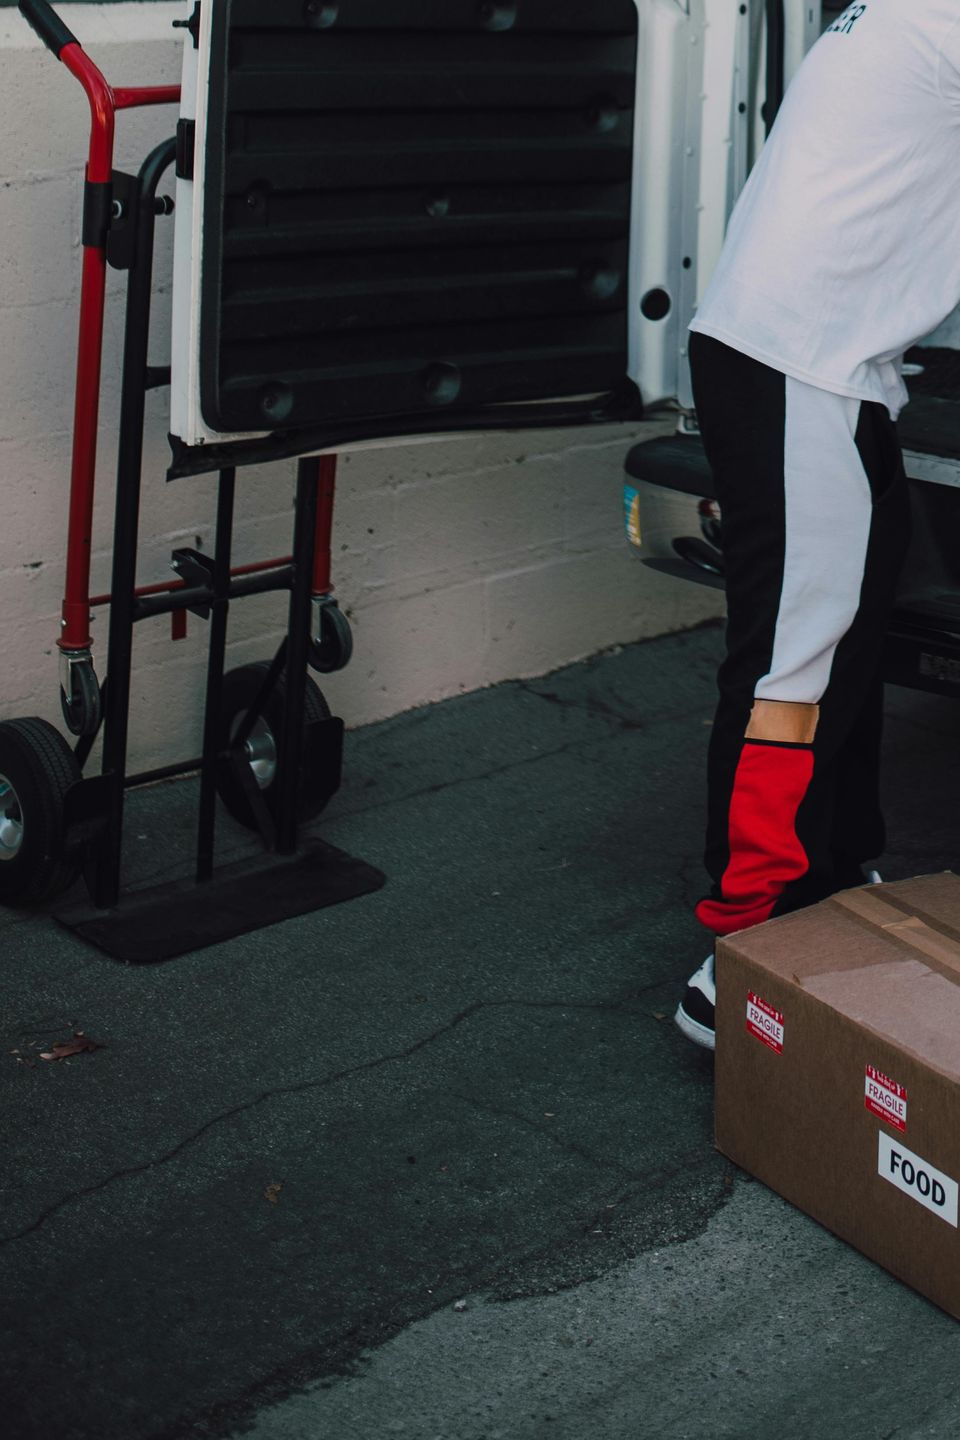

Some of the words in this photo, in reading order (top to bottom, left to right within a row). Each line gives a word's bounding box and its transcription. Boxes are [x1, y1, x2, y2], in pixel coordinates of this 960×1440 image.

[750, 1007, 781, 1040] FRAGILE
[868, 1083, 904, 1116] FRAGILE
[890, 1148, 946, 1207] FOOD
